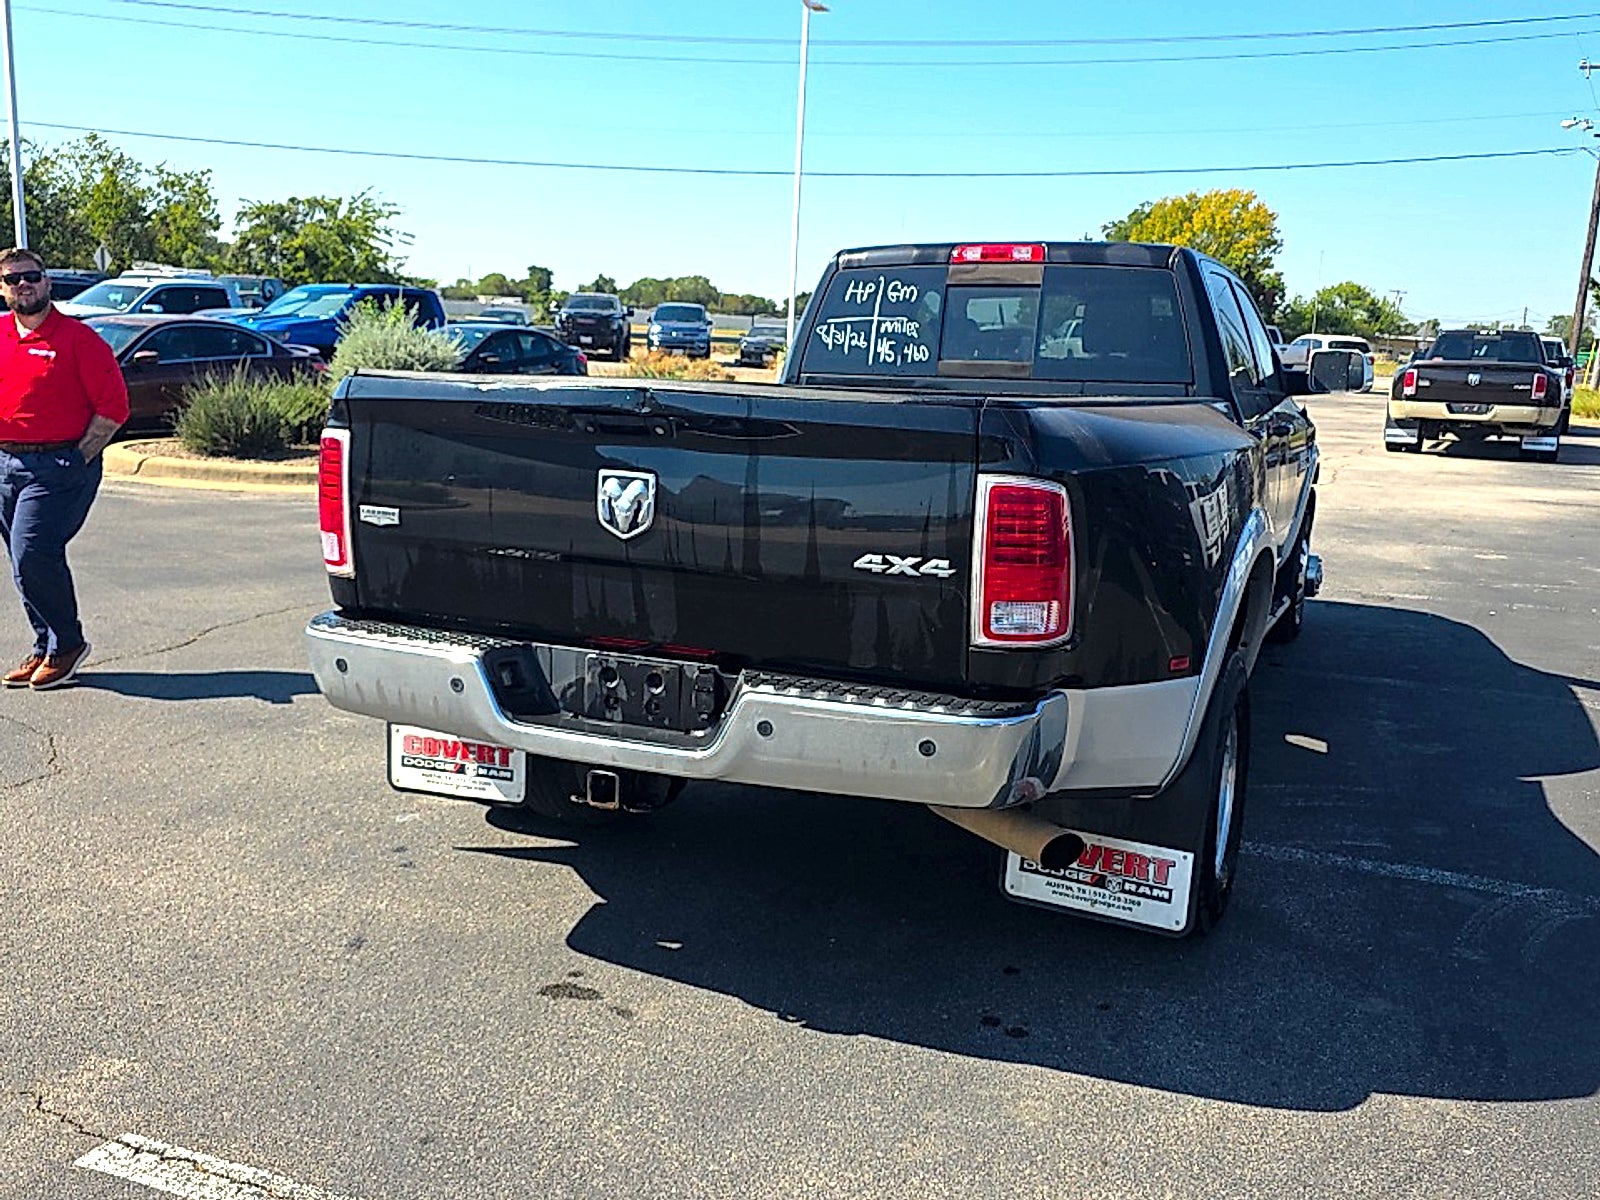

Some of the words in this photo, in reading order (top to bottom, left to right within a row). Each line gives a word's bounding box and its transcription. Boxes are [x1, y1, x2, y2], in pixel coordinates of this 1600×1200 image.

[845, 280, 876, 304] HP
[877, 337, 930, 367] 45,460
[403, 734, 514, 767] COVERT
[403, 757, 458, 772] DODGE
[478, 767, 512, 779] RAM
[1077, 843, 1177, 886] VERT
[1123, 882, 1170, 900] RAM
